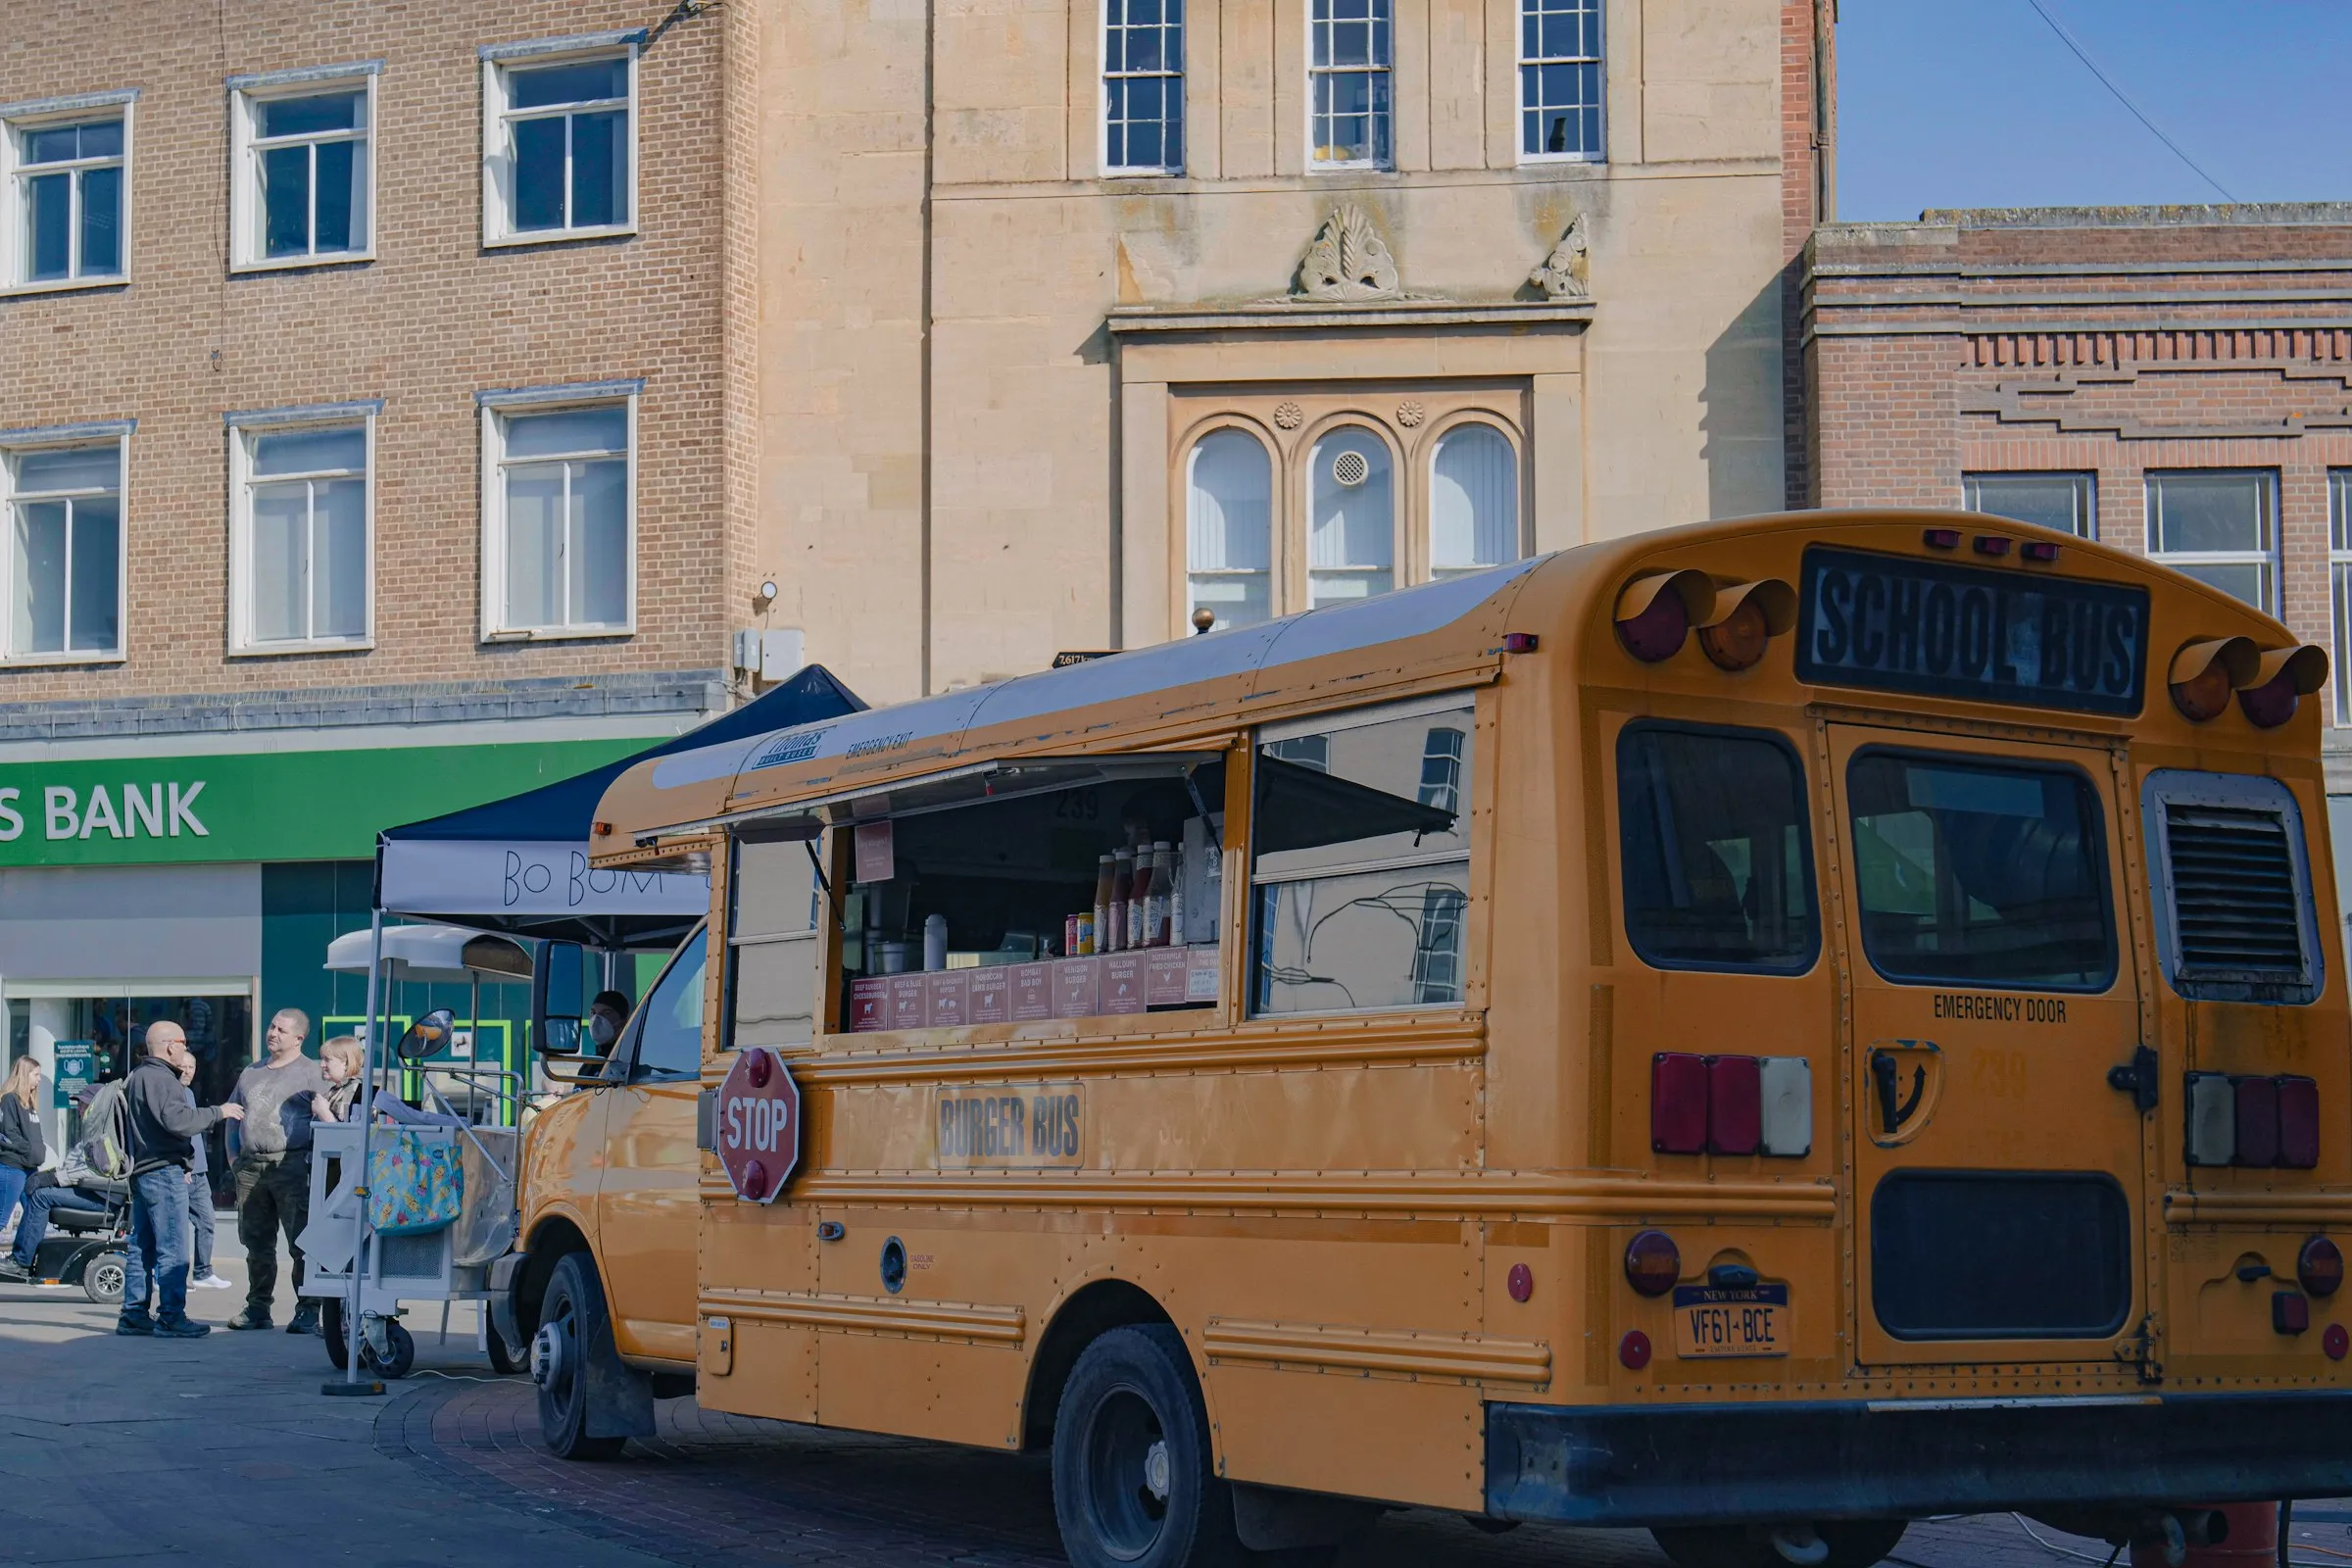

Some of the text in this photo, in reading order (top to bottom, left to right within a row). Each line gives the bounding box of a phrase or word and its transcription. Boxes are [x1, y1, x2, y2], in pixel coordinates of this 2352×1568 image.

[1817, 568, 2133, 695] SCHOOL BUS
[845, 731, 914, 760] EMERGENCY EXIT
[759, 748, 814, 765] BUILT BUSES
[45, 781, 210, 841] BANK
[1054, 790, 1100, 821] 239
[1152, 952, 1182, 961] BUTTERMILK
[1064, 964, 1089, 974] VENISON
[1108, 958, 1137, 969] HALLOUMI
[1163, 961, 1186, 970] CHICKEN
[1020, 968, 1042, 977] BOMBAY
[1111, 970, 1134, 980] BURGER
[1065, 975, 1087, 985] BURGER
[986, 982, 1006, 992] BURGER
[899, 989, 918, 998] BURGER
[1934, 995, 2067, 1024] EMERGENCY DOOR
[728, 1097, 788, 1152] STOP
[941, 1095, 1079, 1157] BURGER BUS
[909, 1254, 934, 1263] GASOLINE
[1703, 1289, 1757, 1300] NEW YORK
